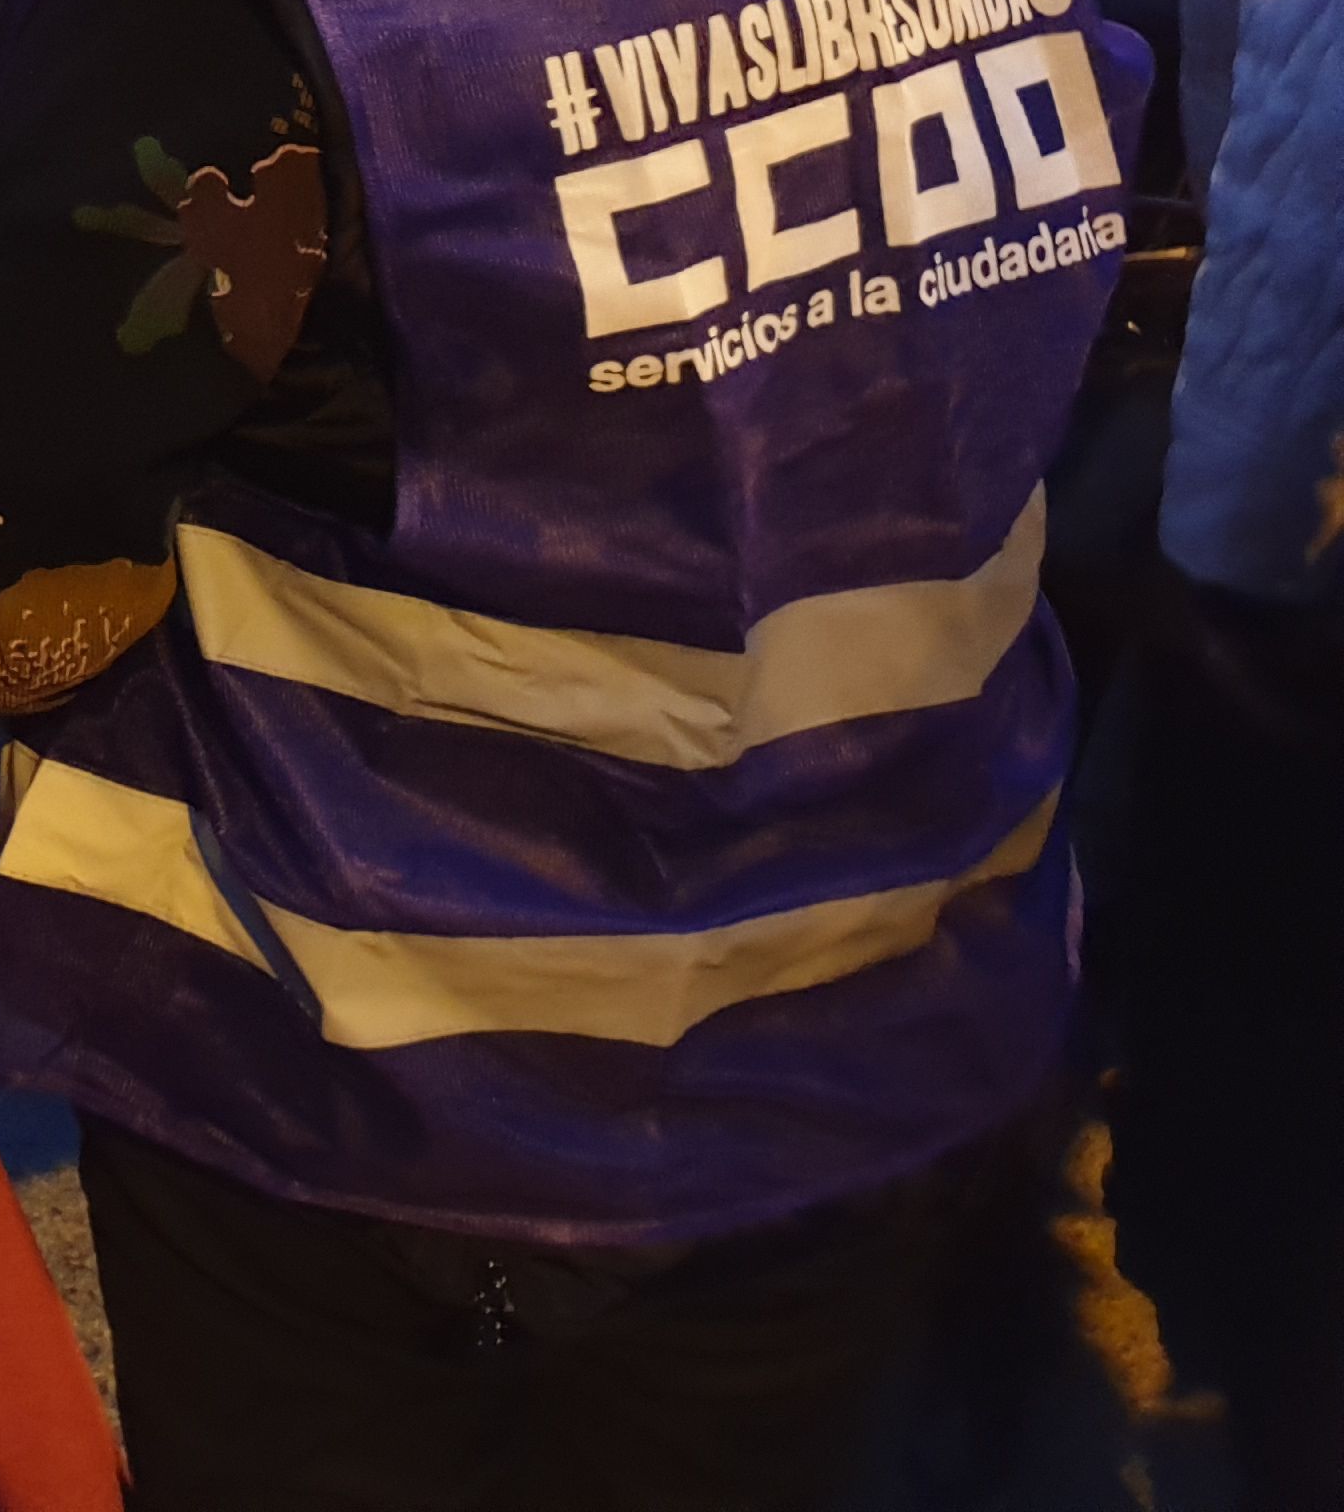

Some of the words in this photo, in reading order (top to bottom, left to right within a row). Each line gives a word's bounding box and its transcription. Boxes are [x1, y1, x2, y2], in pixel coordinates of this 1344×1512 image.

[555, 30, 1122, 338] CCOO
[588, 303, 799, 392] servicios
[807, 288, 835, 328] a
[849, 269, 901, 318] la
